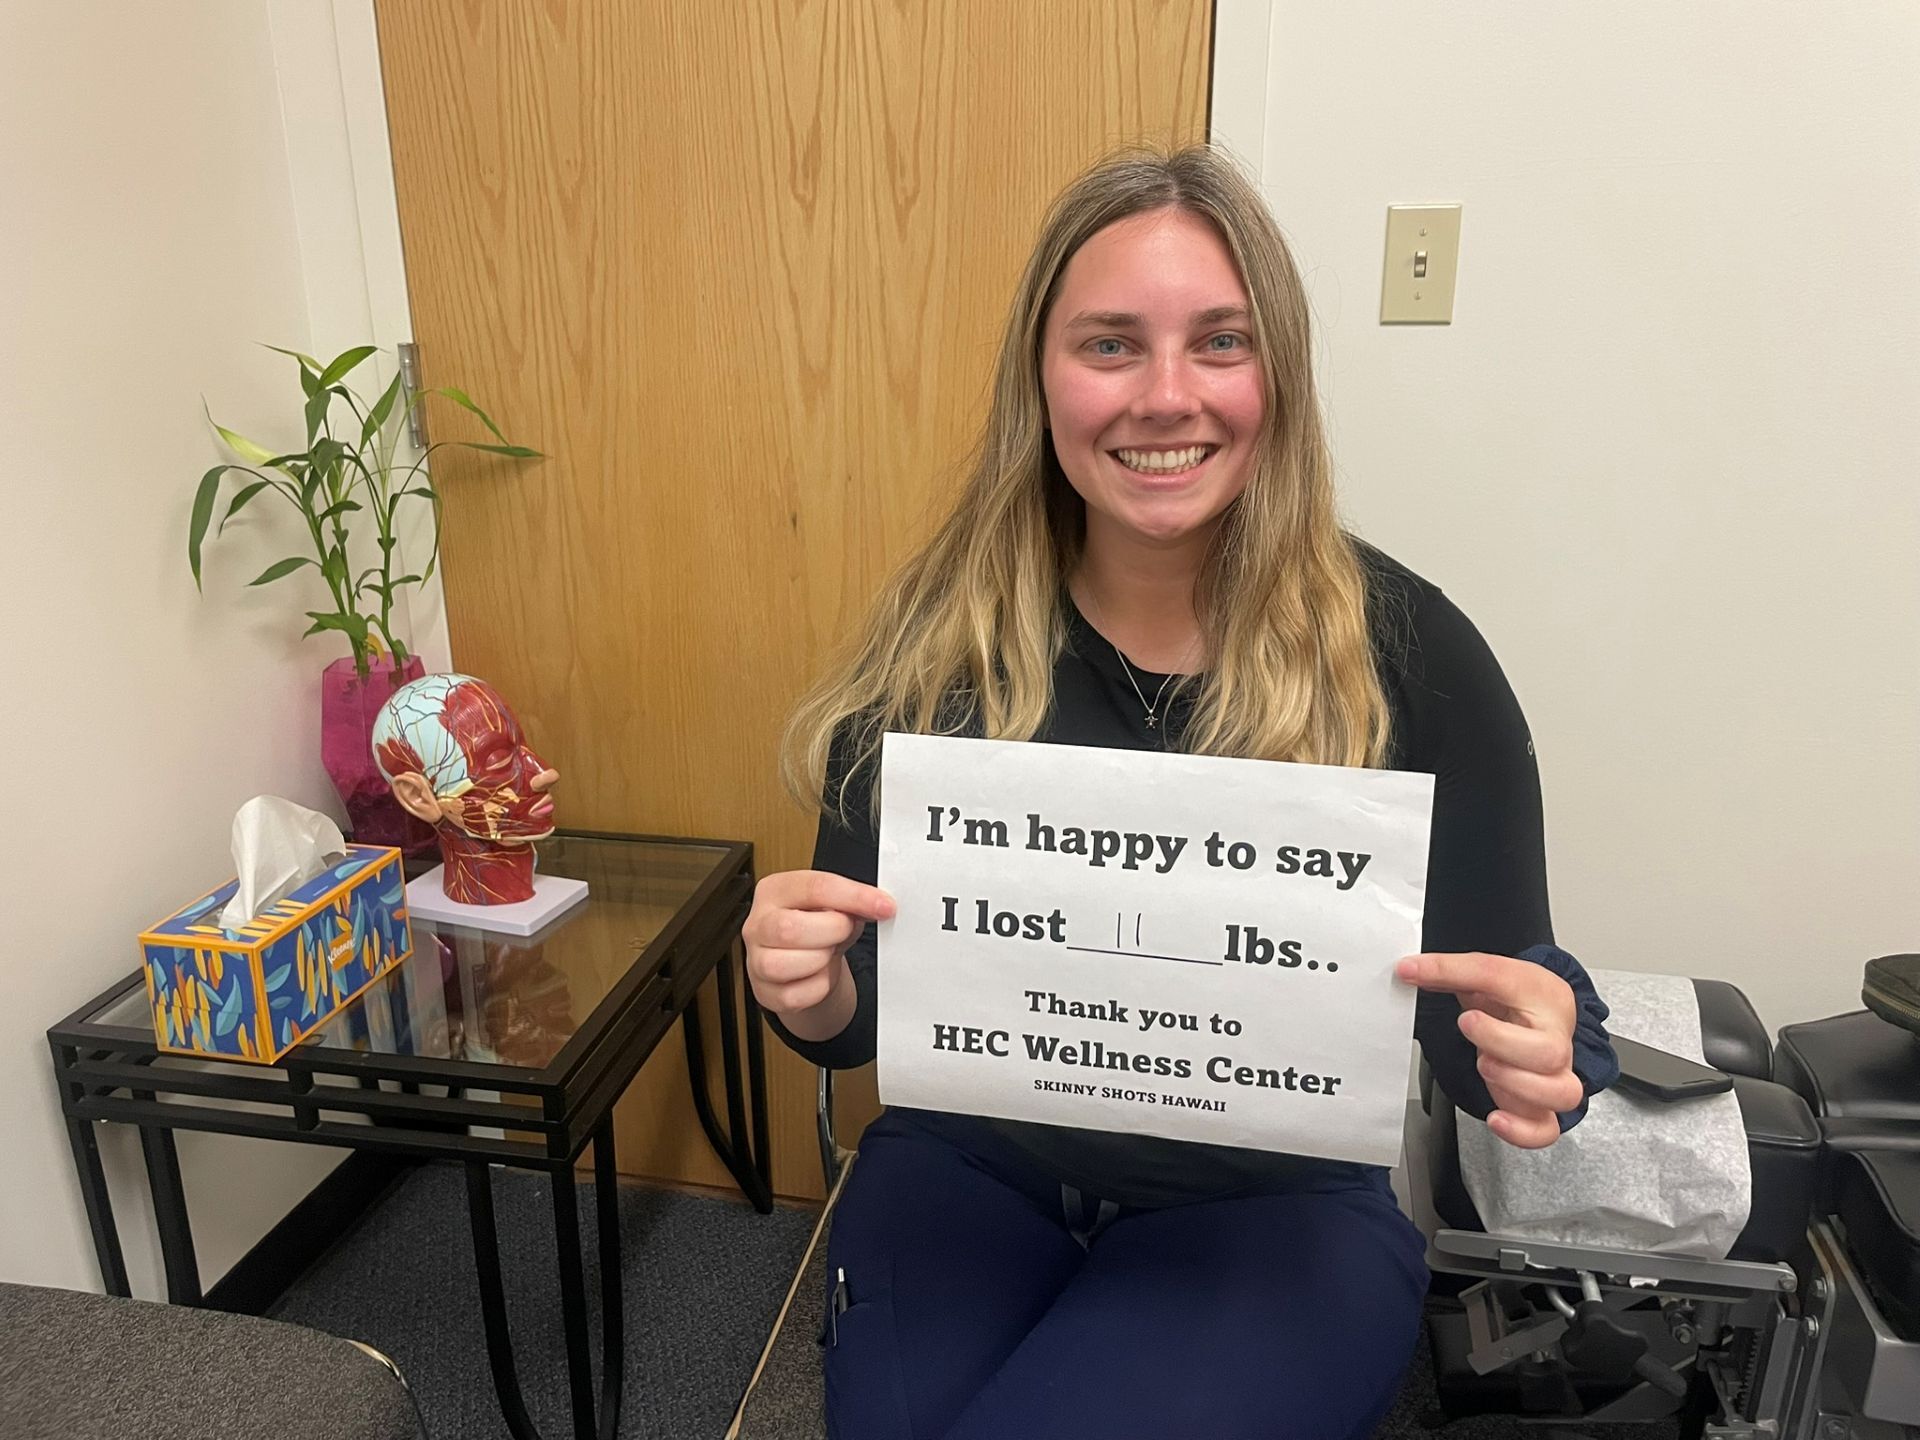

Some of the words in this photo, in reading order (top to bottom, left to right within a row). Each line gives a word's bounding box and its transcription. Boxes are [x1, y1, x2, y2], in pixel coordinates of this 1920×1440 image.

[926, 805, 1010, 848] I’m
[1025, 813, 1188, 874] happy
[1204, 831, 1257, 870] to
[1276, 846, 1372, 891] say
[941, 896, 959, 932] I
[975, 899, 1067, 943] lost
[1024, 990, 1129, 1023] Thank
[1138, 1009, 1199, 1032] you
[1209, 1013, 1242, 1037] to
[932, 1023, 1009, 1057] HEC
[1021, 1033, 1192, 1079] Wellness
[1206, 1056, 1342, 1096] Center
[1034, 1079, 1097, 1097] SKINNY
[1101, 1086, 1157, 1104] SHOTS
[1161, 1094, 1226, 1113] HAWAII
